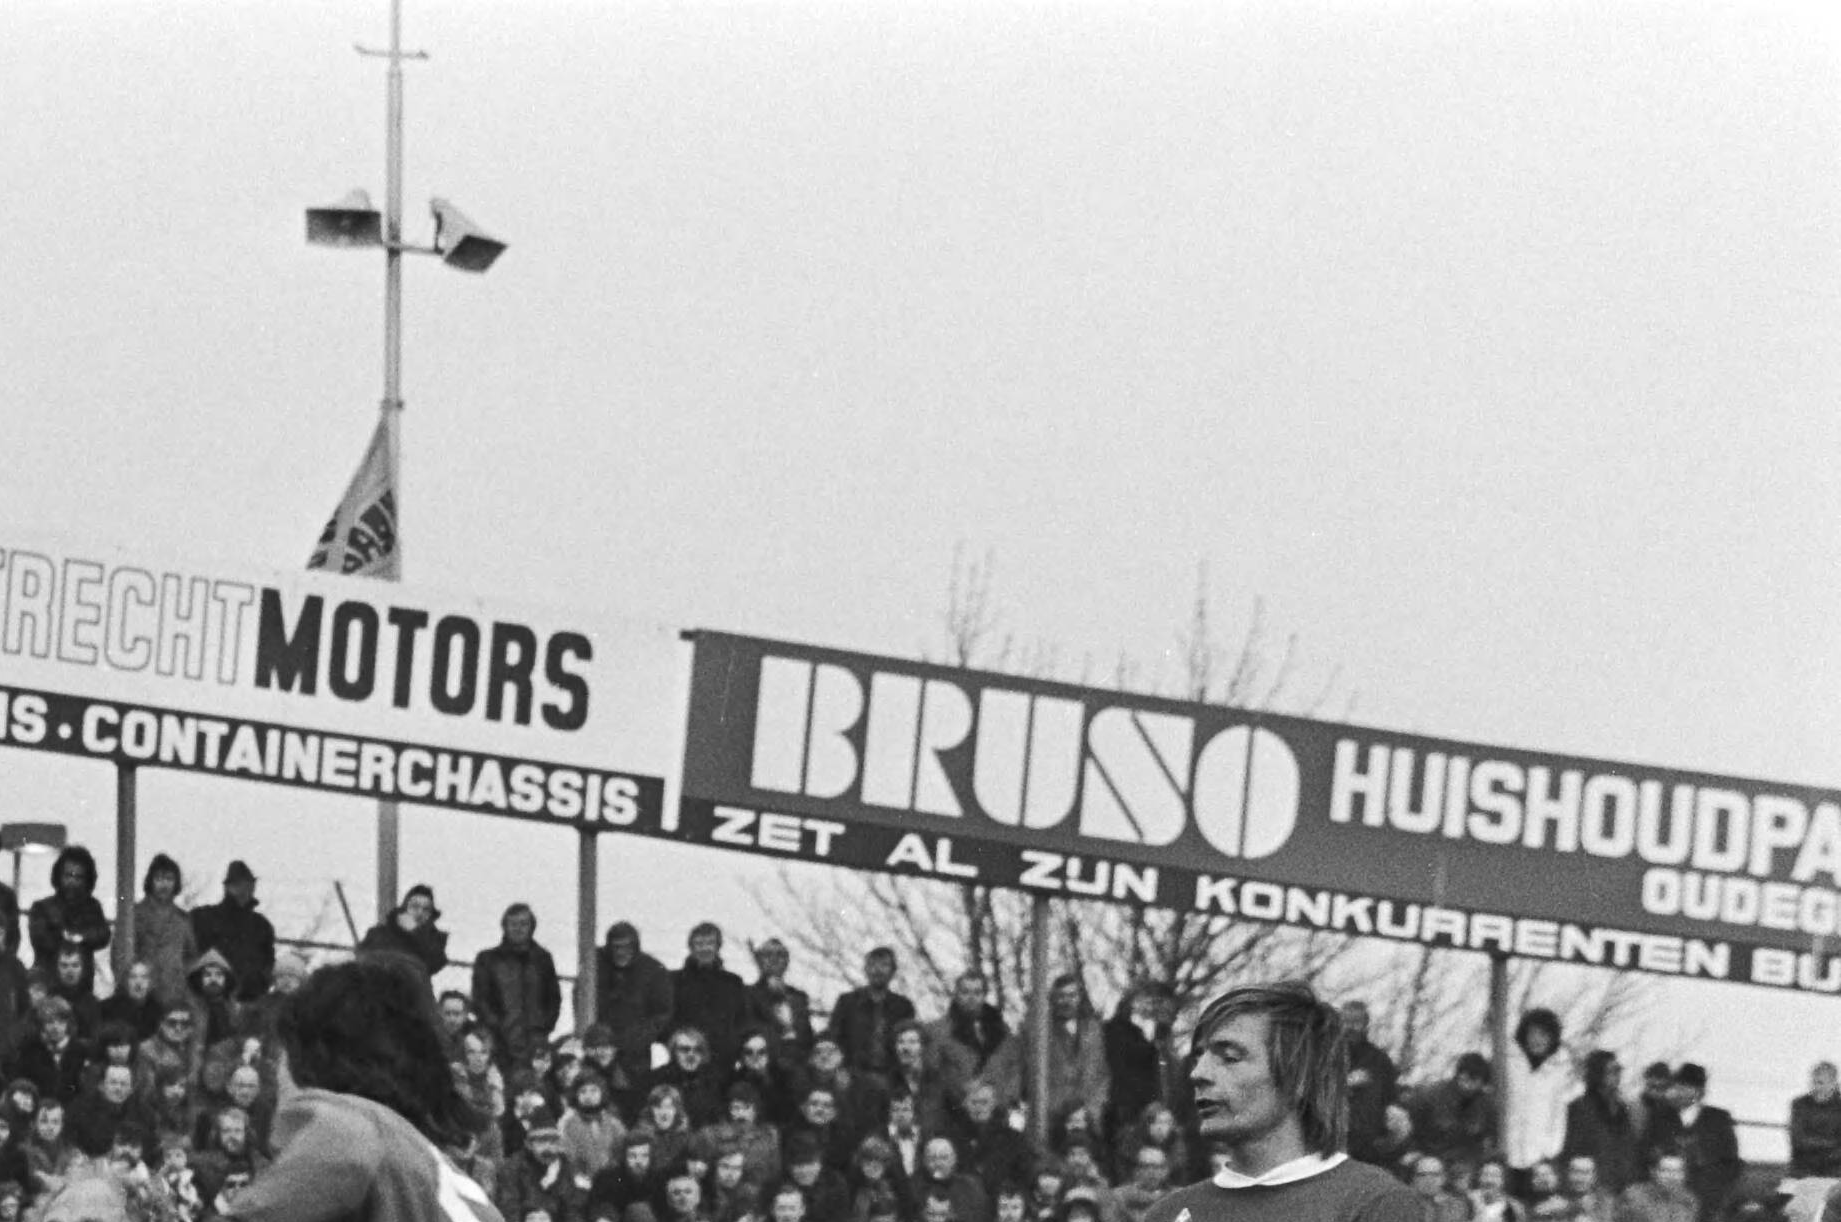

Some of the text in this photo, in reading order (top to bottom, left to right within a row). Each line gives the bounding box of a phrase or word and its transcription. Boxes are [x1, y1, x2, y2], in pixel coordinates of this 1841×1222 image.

[253, 587, 594, 731] MOTORS
[81, 703, 639, 826] CONTAINERCHASSIS
[751, 653, 1300, 860] BRUSO
[711, 805, 846, 860] ZET
[885, 832, 979, 880] AL
[1194, 873, 1731, 980] KONKURRENTEN
